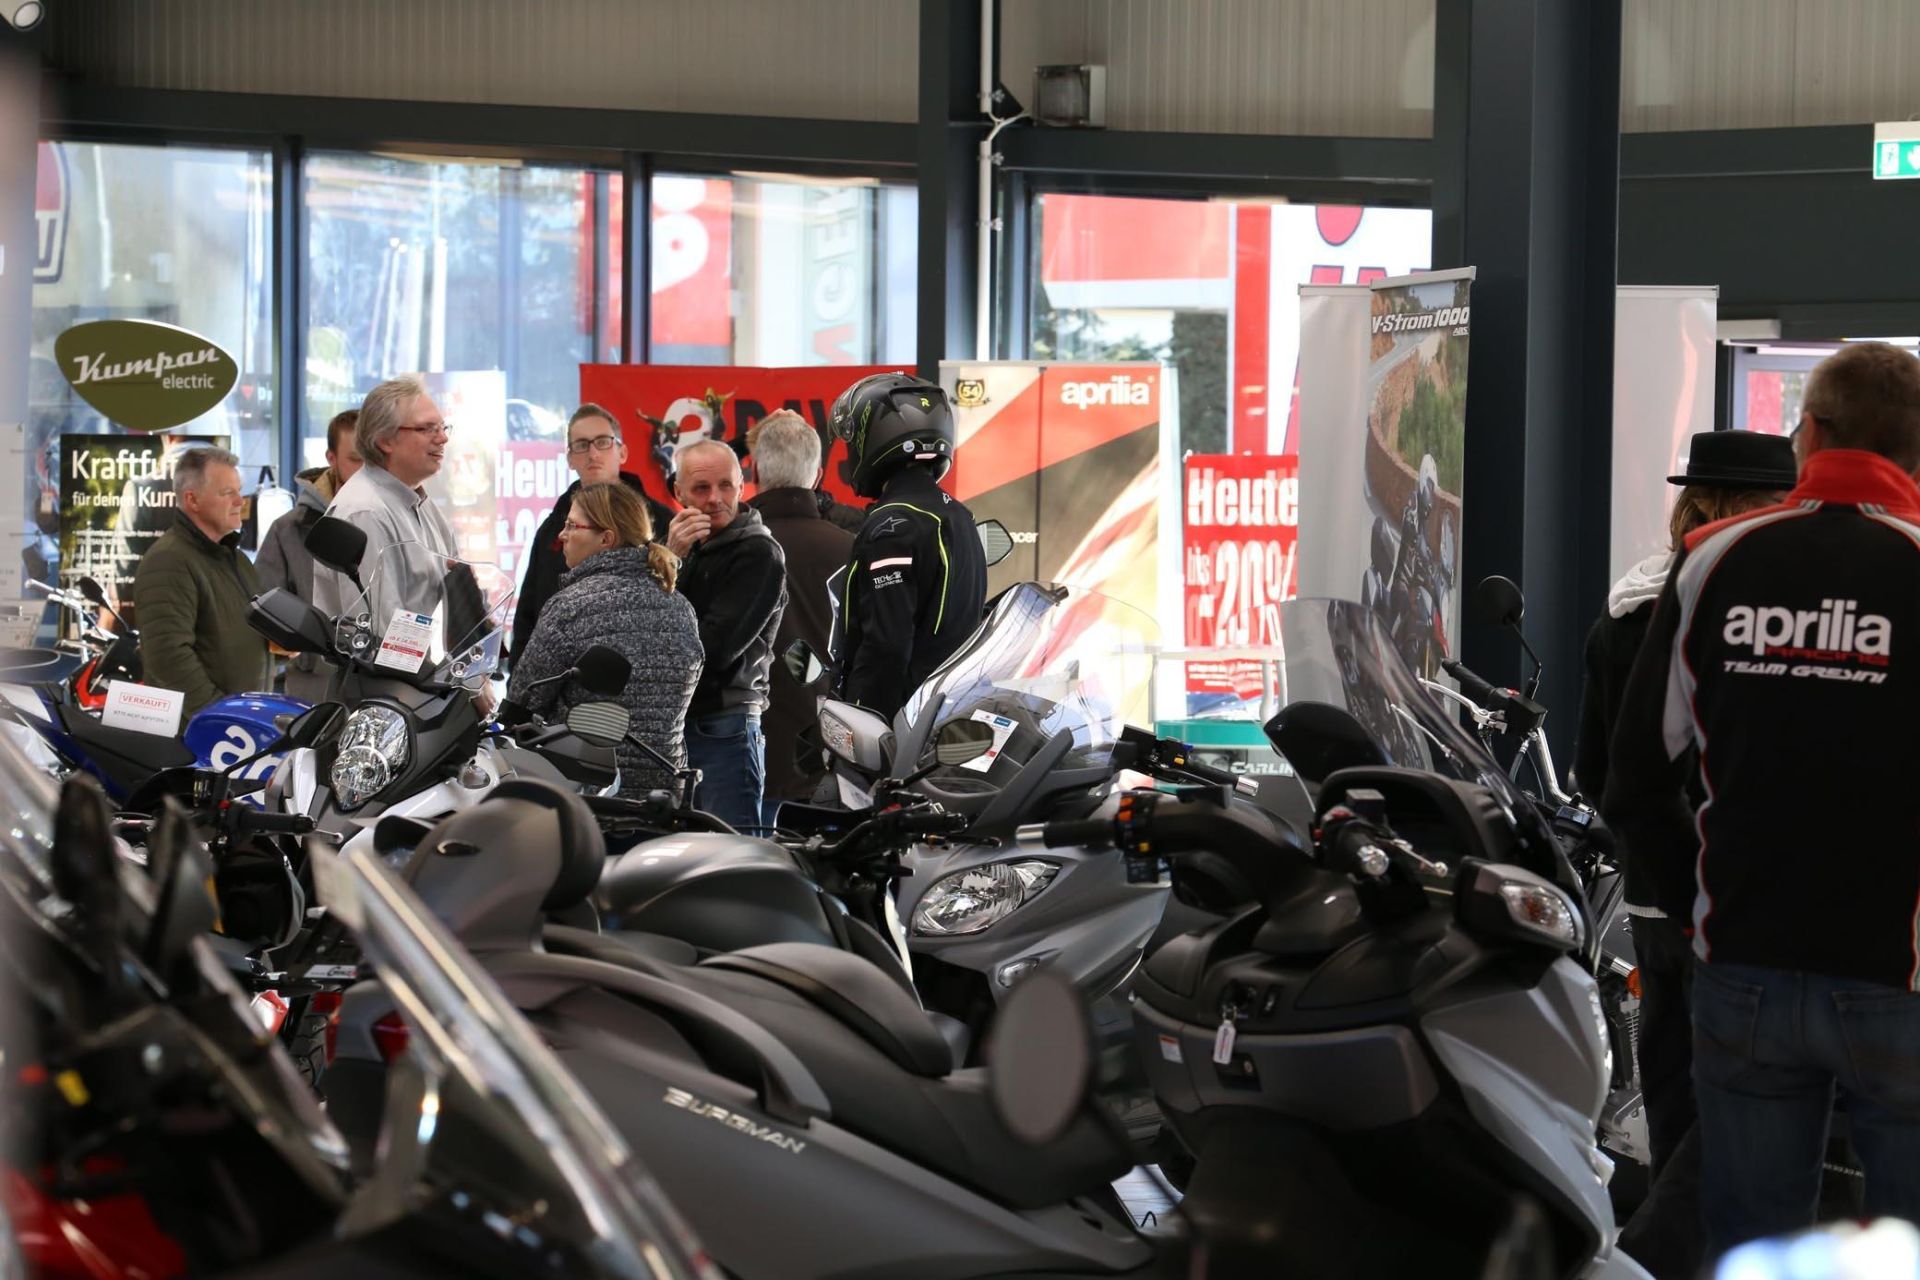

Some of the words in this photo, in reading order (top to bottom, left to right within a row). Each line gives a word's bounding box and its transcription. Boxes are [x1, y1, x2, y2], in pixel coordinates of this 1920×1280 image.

[72, 348, 220, 385] Kumpan
[162, 374, 215, 389] electric
[1061, 375, 1150, 410] aprilia
[72, 449, 179, 480] Kraftfut
[495, 450, 578, 499] Heut
[72, 491, 91, 507] für
[138, 486, 177, 508] Kum
[1187, 468, 1298, 526] Heute
[1009, 531, 1039, 543] acer
[1723, 599, 1892, 656] aprilia
[1723, 660, 1788, 676] TEAM
[122, 694, 168, 709] VERKAUFT
[662, 1086, 806, 1154] BURGMAN
